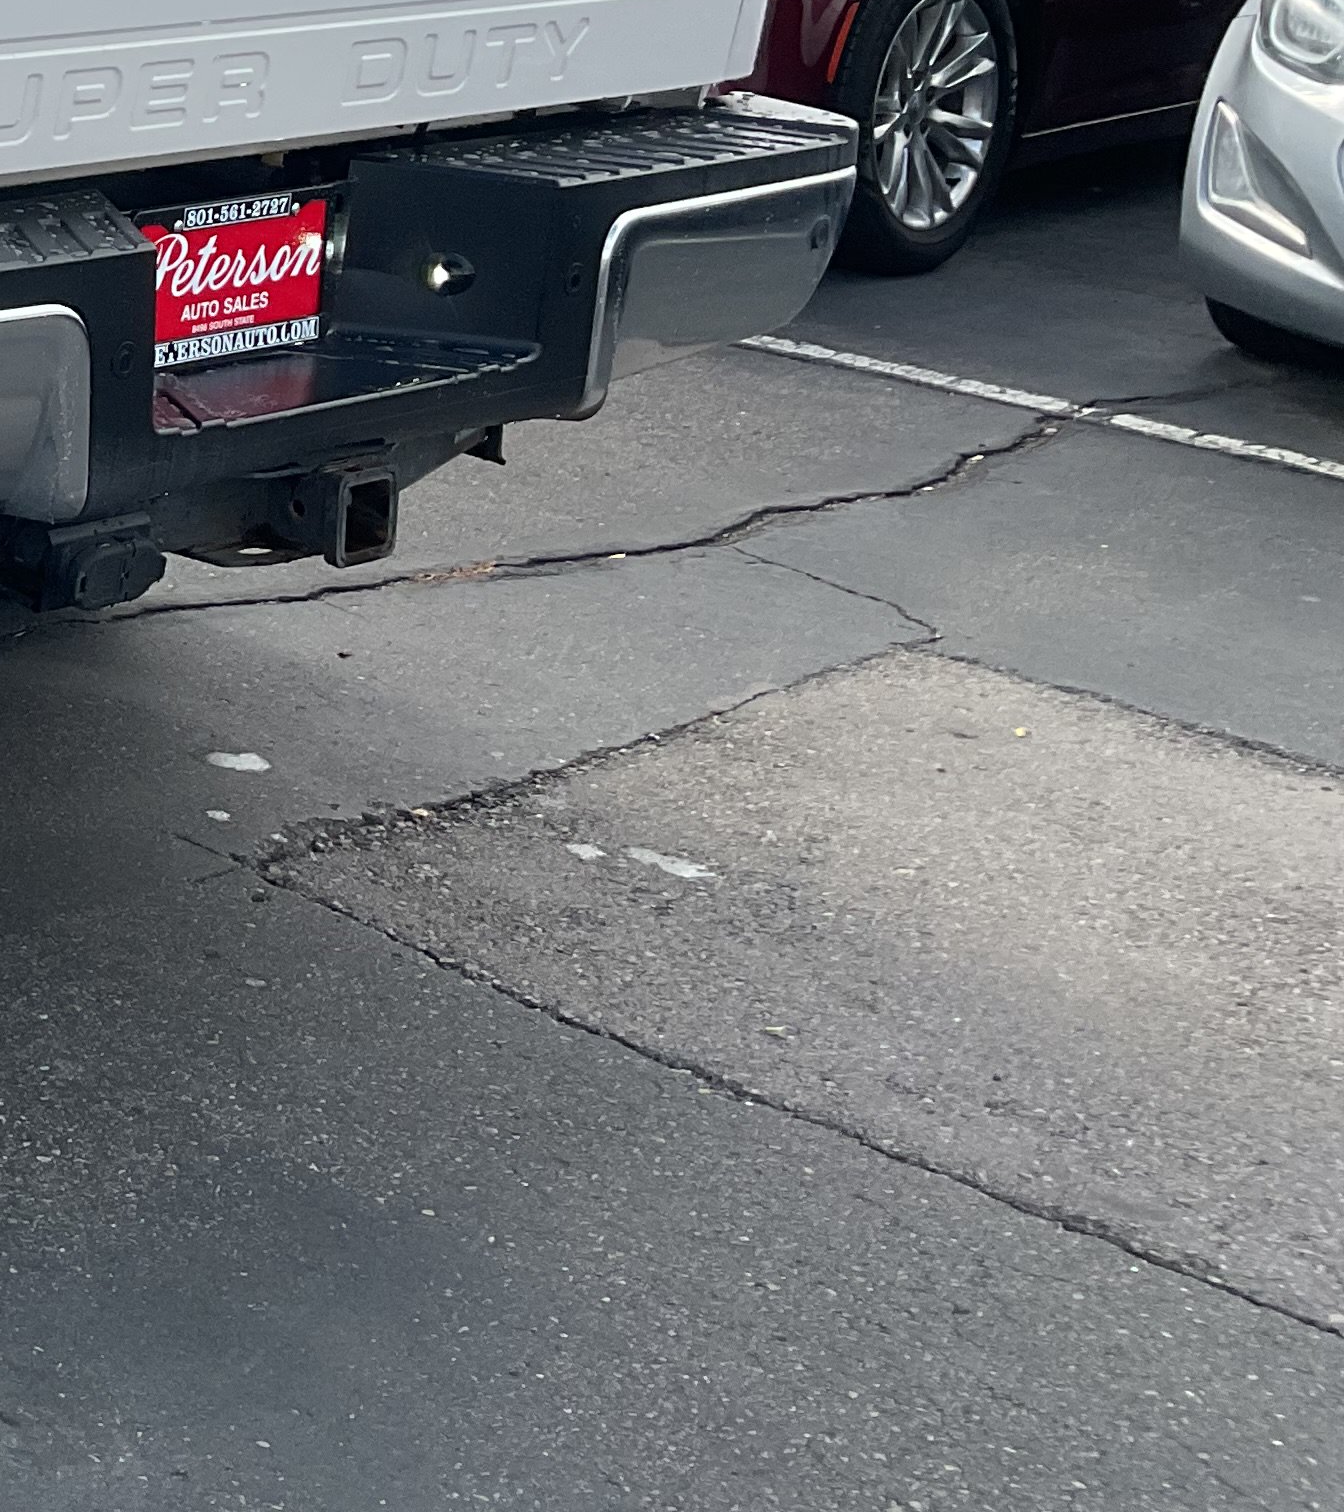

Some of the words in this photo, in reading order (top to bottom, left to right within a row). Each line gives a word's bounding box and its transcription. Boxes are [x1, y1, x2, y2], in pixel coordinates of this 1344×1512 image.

[341, 17, 590, 107] DUTY
[186, 196, 289, 228] 801-561-2727
[154, 233, 321, 297] Peterson
[181, 299, 220, 322] AUTO
[223, 291, 269, 315] SALES
[208, 318, 233, 331] SOUTH
[234, 315, 254, 327] STATE
[155, 319, 316, 364] ETERSONAUTO.COM
